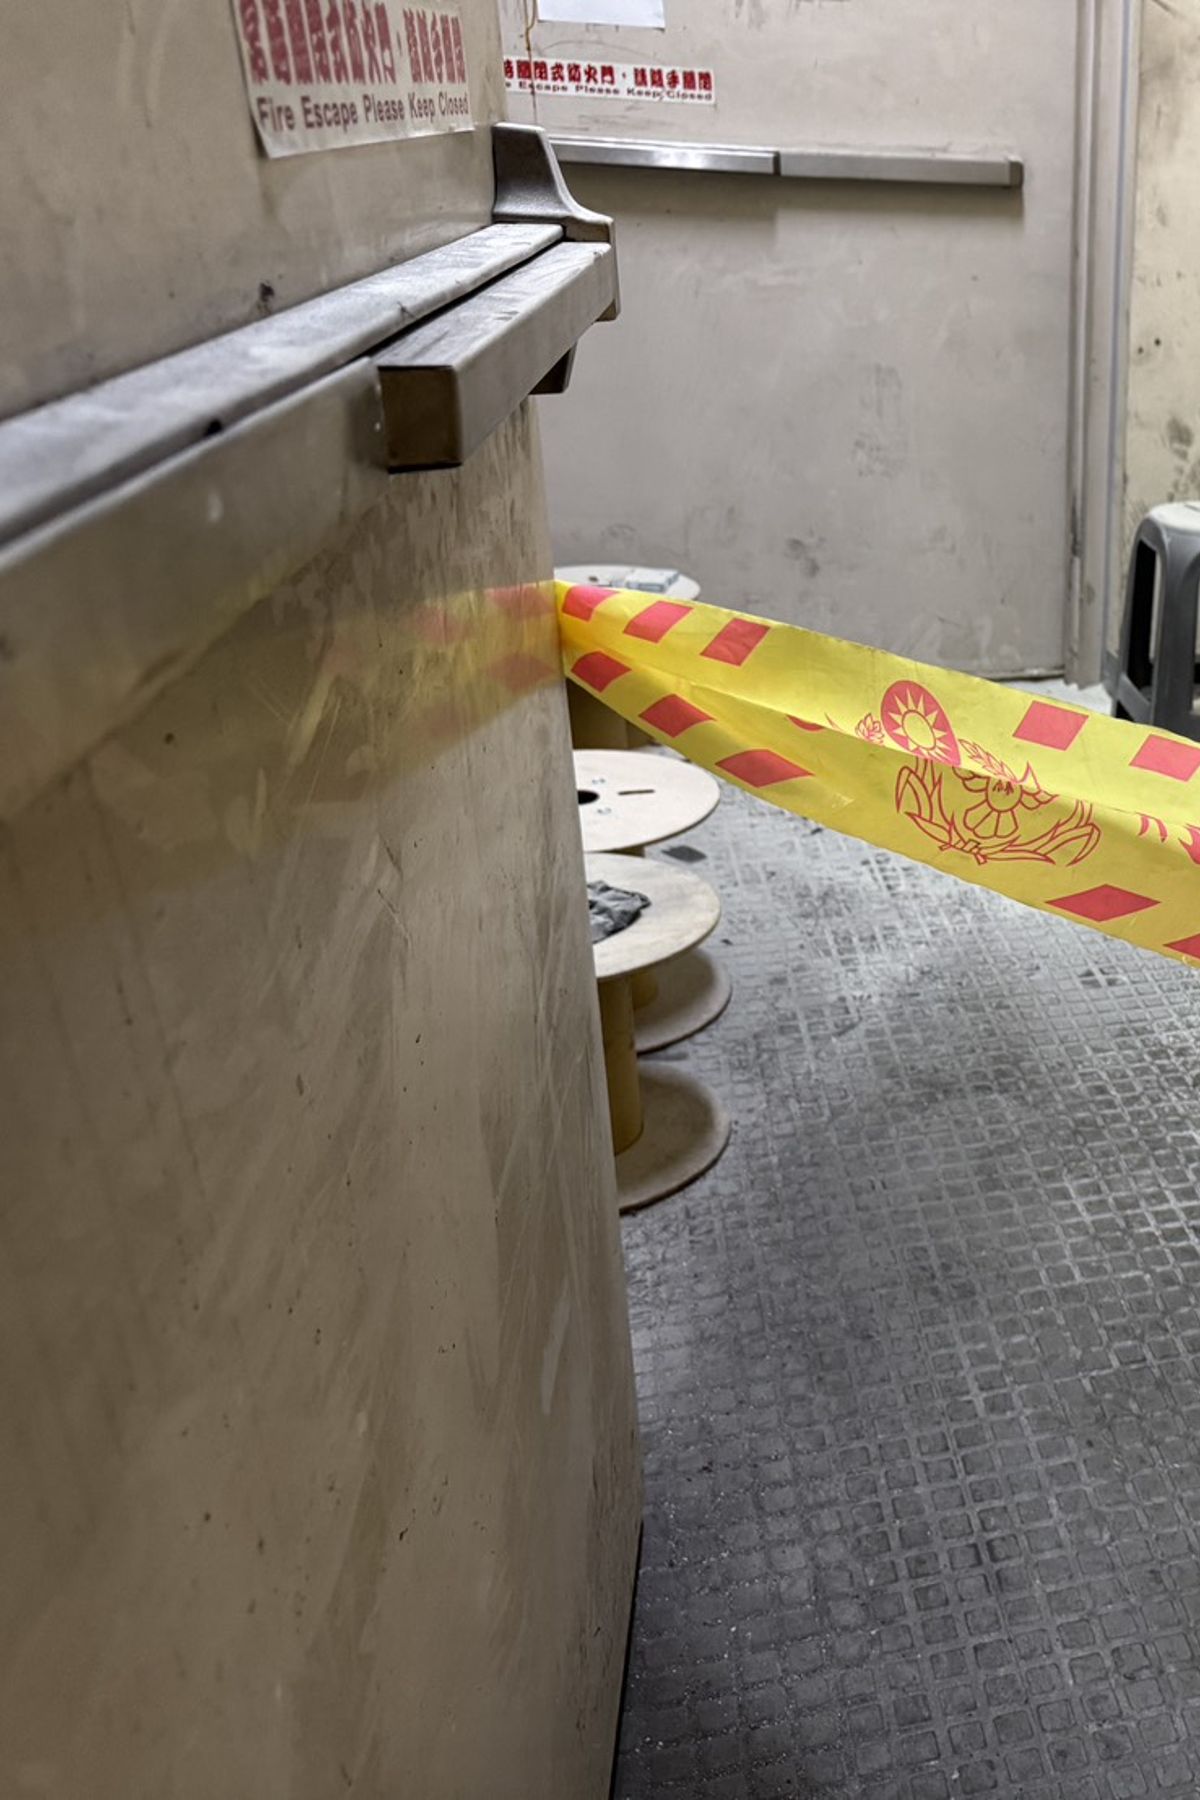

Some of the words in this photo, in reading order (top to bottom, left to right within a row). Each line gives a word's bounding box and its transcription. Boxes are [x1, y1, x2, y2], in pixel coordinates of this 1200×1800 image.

[519, 80, 568, 92] Escape
[575, 84, 620, 95] Please
[627, 88, 661, 98] Keep
[666, 90, 712, 100] Closed
[257, 97, 295, 132] Fire
[301, 96, 358, 133] Escape
[363, 93, 405, 123] Please
[408, 92, 435, 123] Keep
[438, 91, 469, 116] Closed
